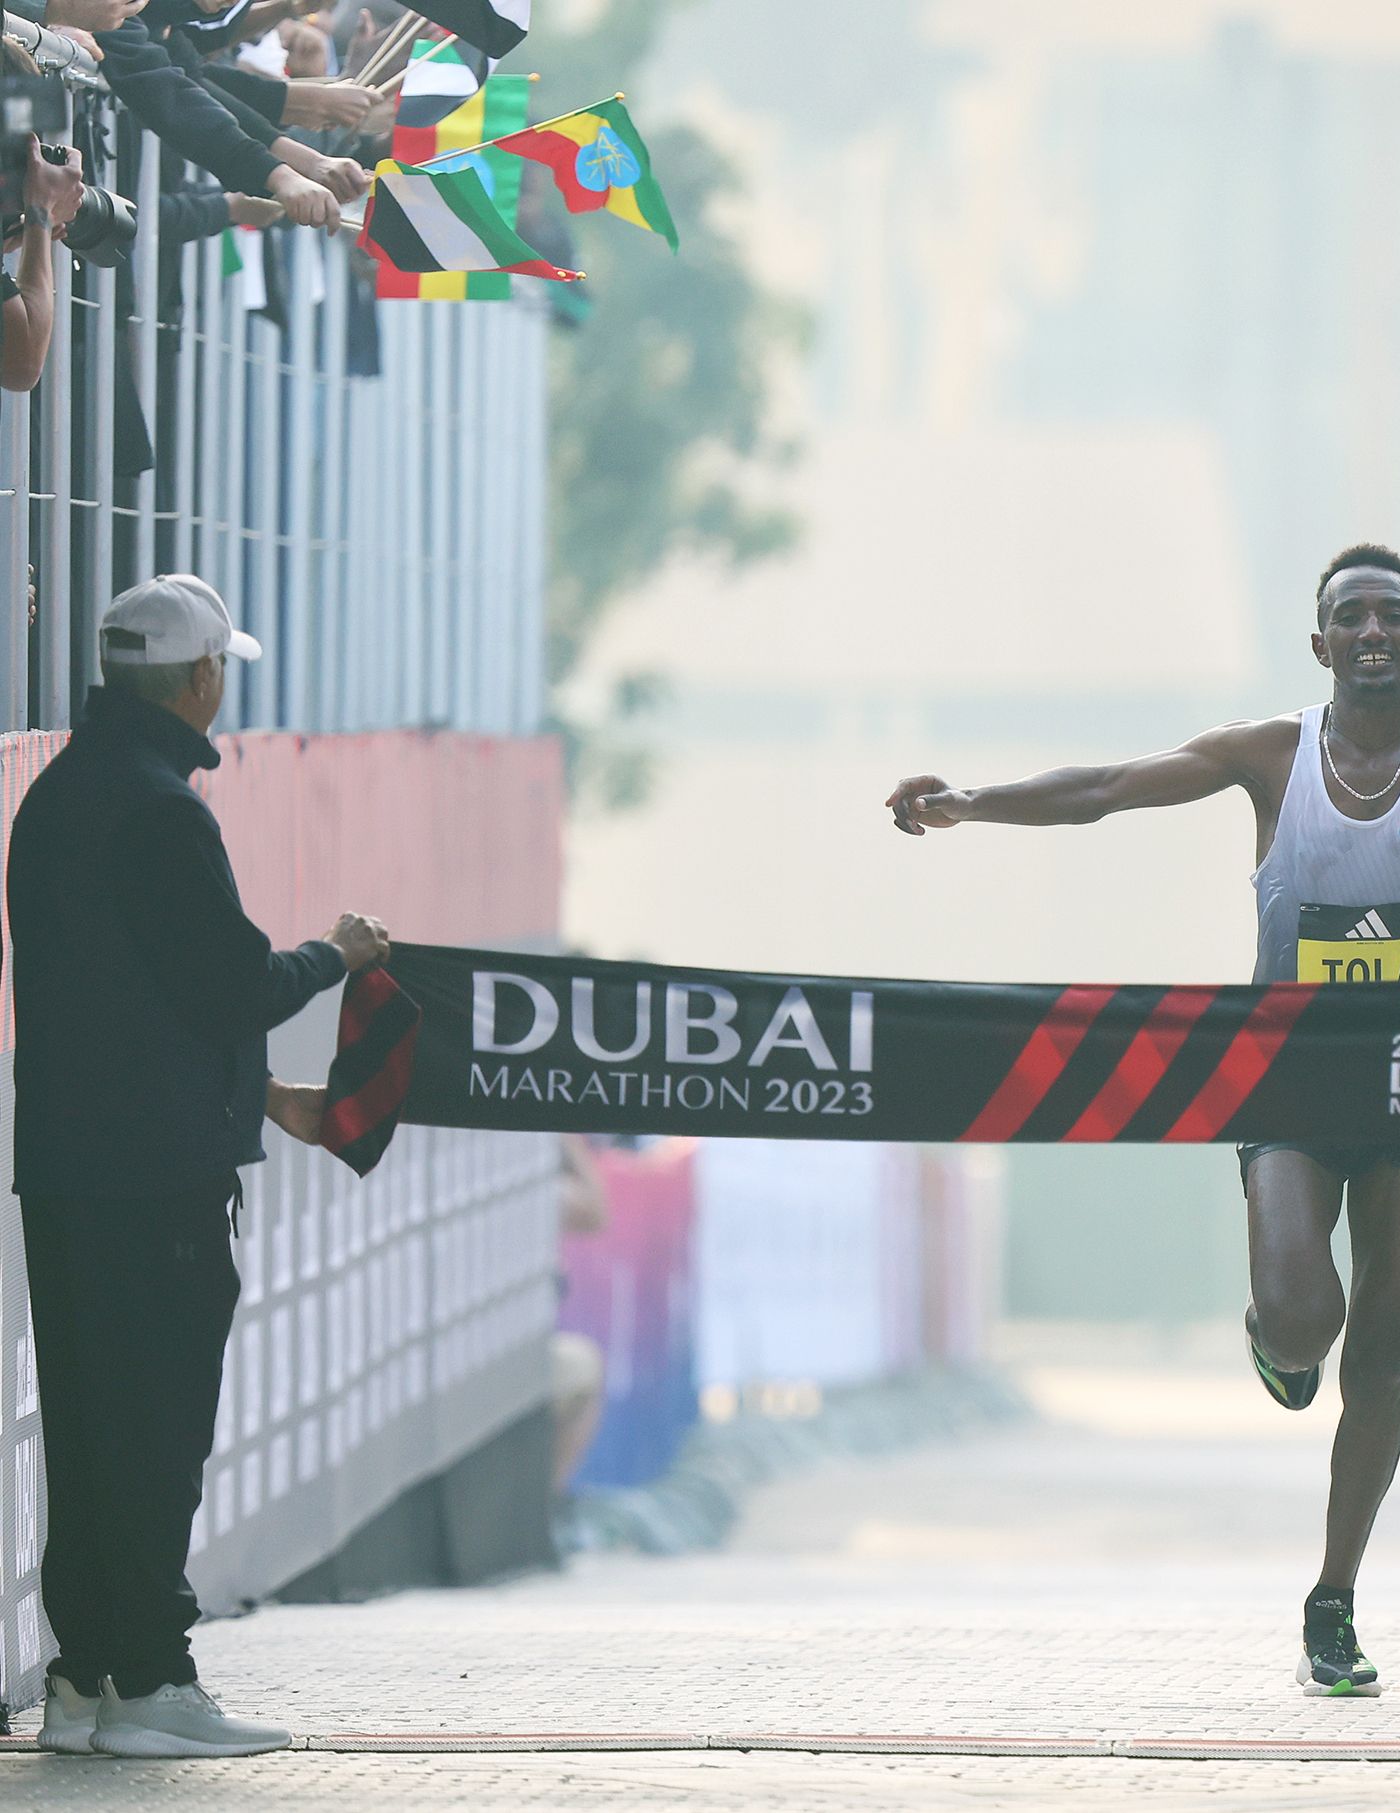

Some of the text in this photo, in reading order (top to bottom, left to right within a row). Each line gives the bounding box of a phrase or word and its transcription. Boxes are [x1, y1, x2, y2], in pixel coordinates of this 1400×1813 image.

[472, 971, 873, 1072] DUBAI
[469, 1063, 874, 1115] MARATHON 2023
